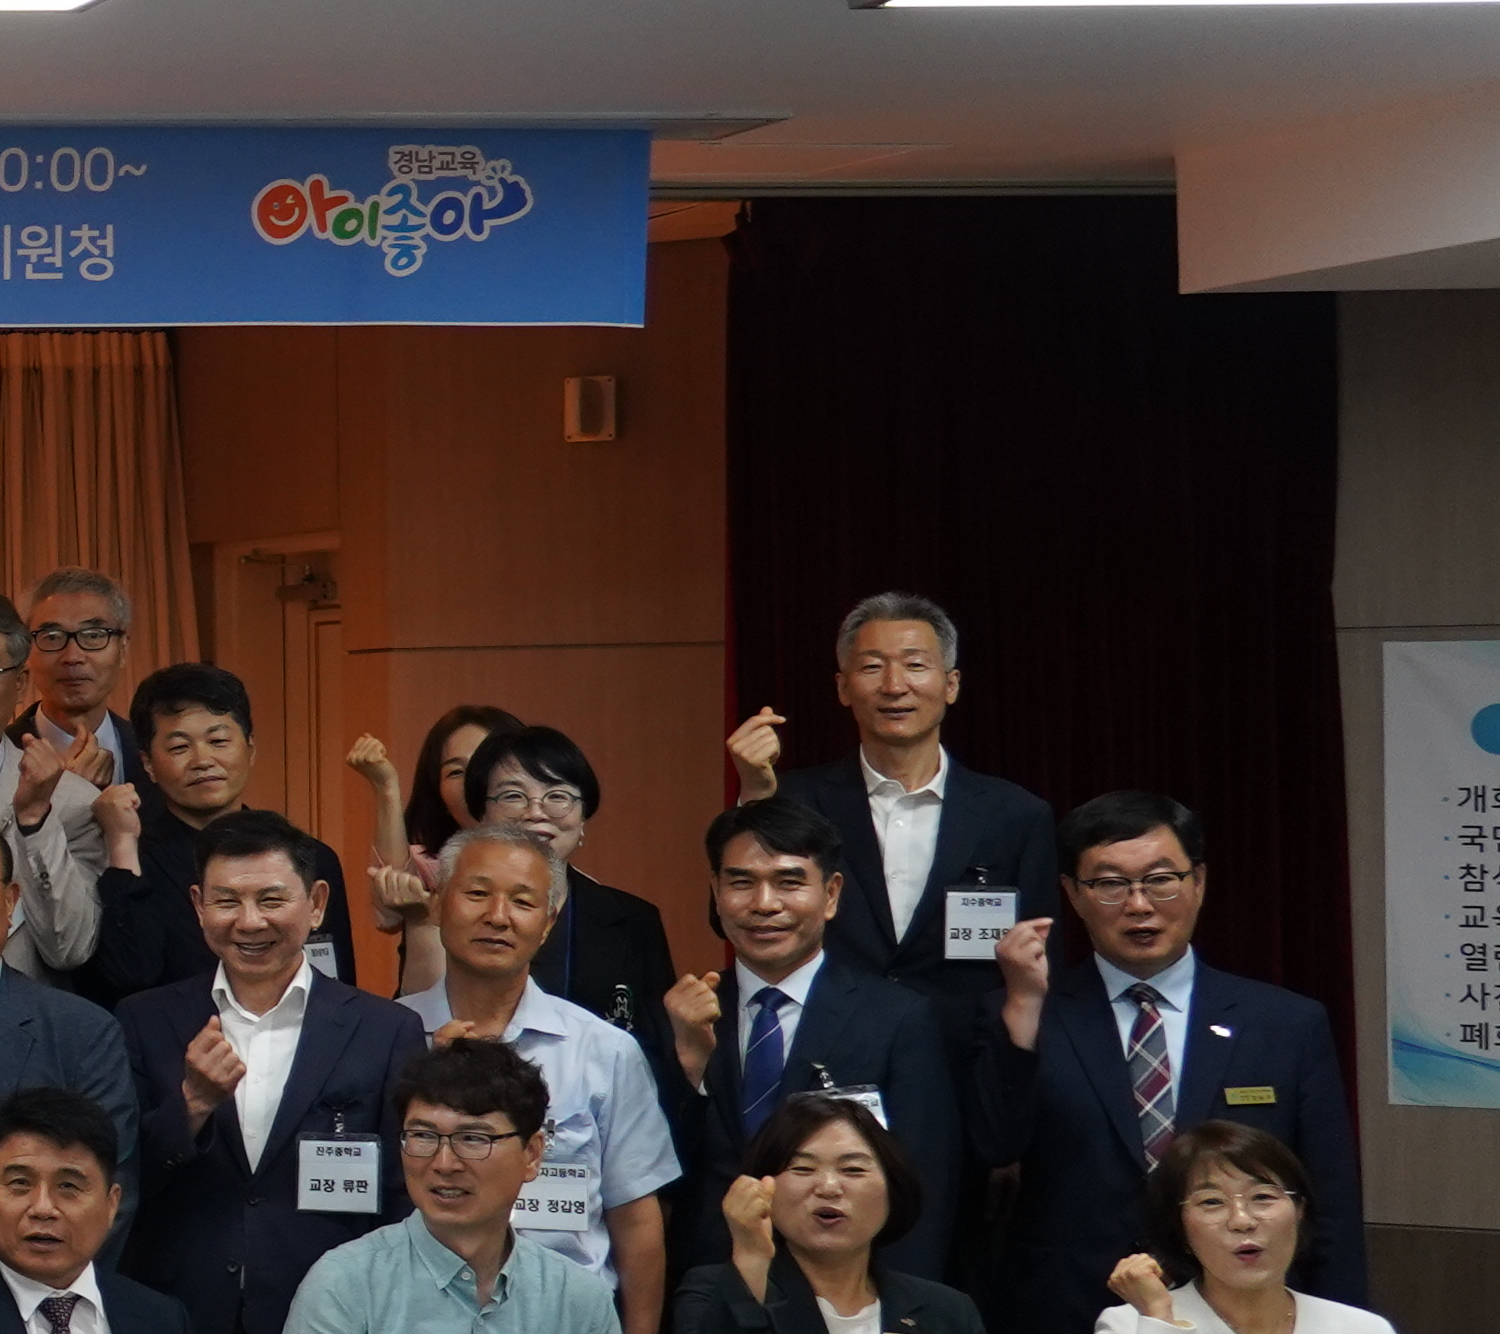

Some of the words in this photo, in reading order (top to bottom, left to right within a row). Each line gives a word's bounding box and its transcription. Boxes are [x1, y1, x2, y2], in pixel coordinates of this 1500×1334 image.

[393, 149, 480, 176] 경남교육
[950, 928, 972, 940] 교장
[317, 1147, 361, 1156] 진주중학교
[310, 1179, 335, 1192] 교장
[515, 1198, 540, 1212] 교장
[548, 1200, 585, 1214] 정갑영
